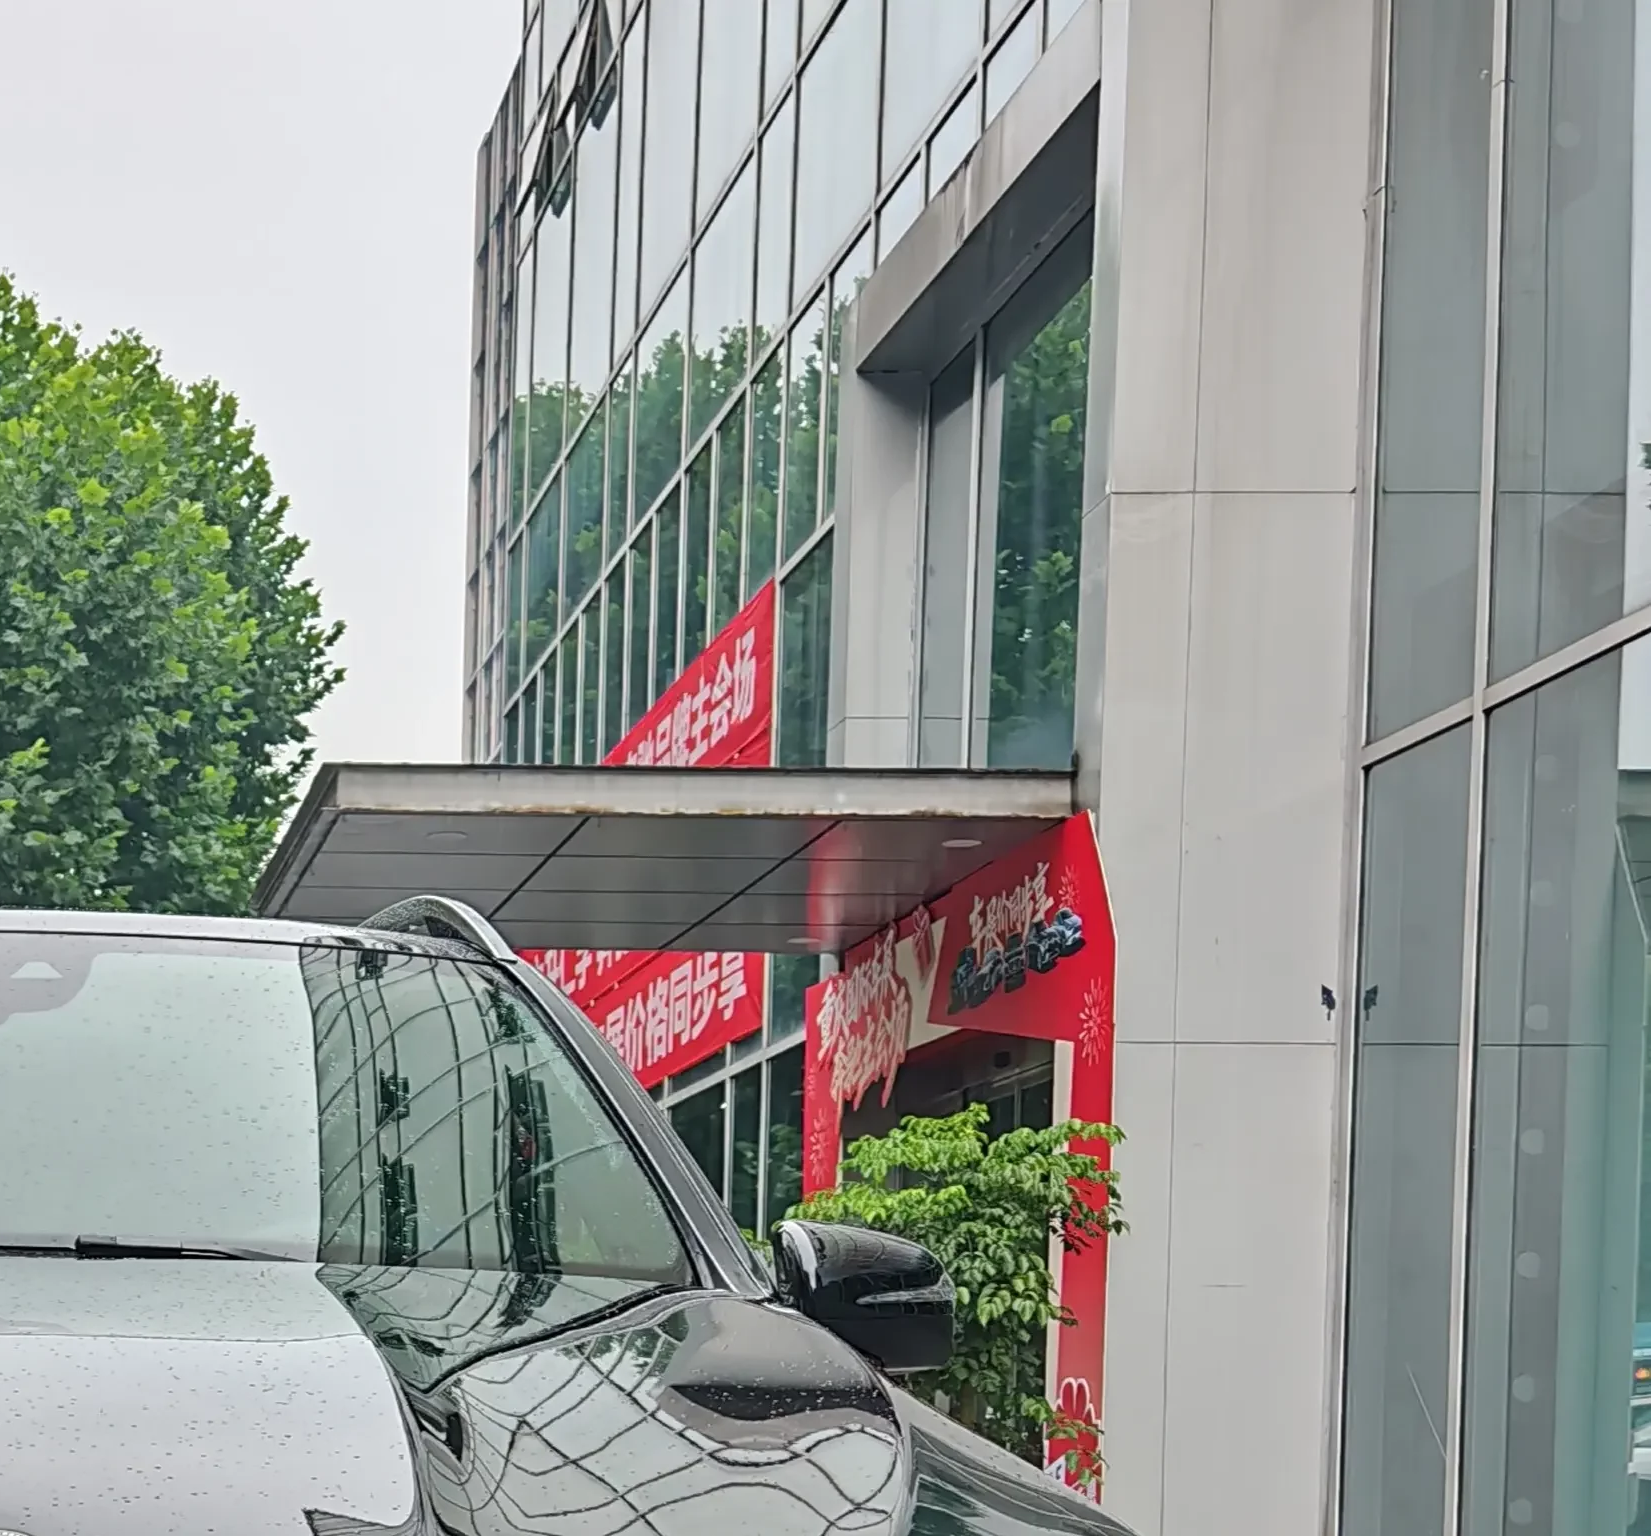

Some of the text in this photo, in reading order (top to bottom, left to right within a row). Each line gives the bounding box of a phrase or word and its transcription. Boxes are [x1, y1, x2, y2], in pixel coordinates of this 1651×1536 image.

[597, 951, 747, 1073] 展价格同步享
